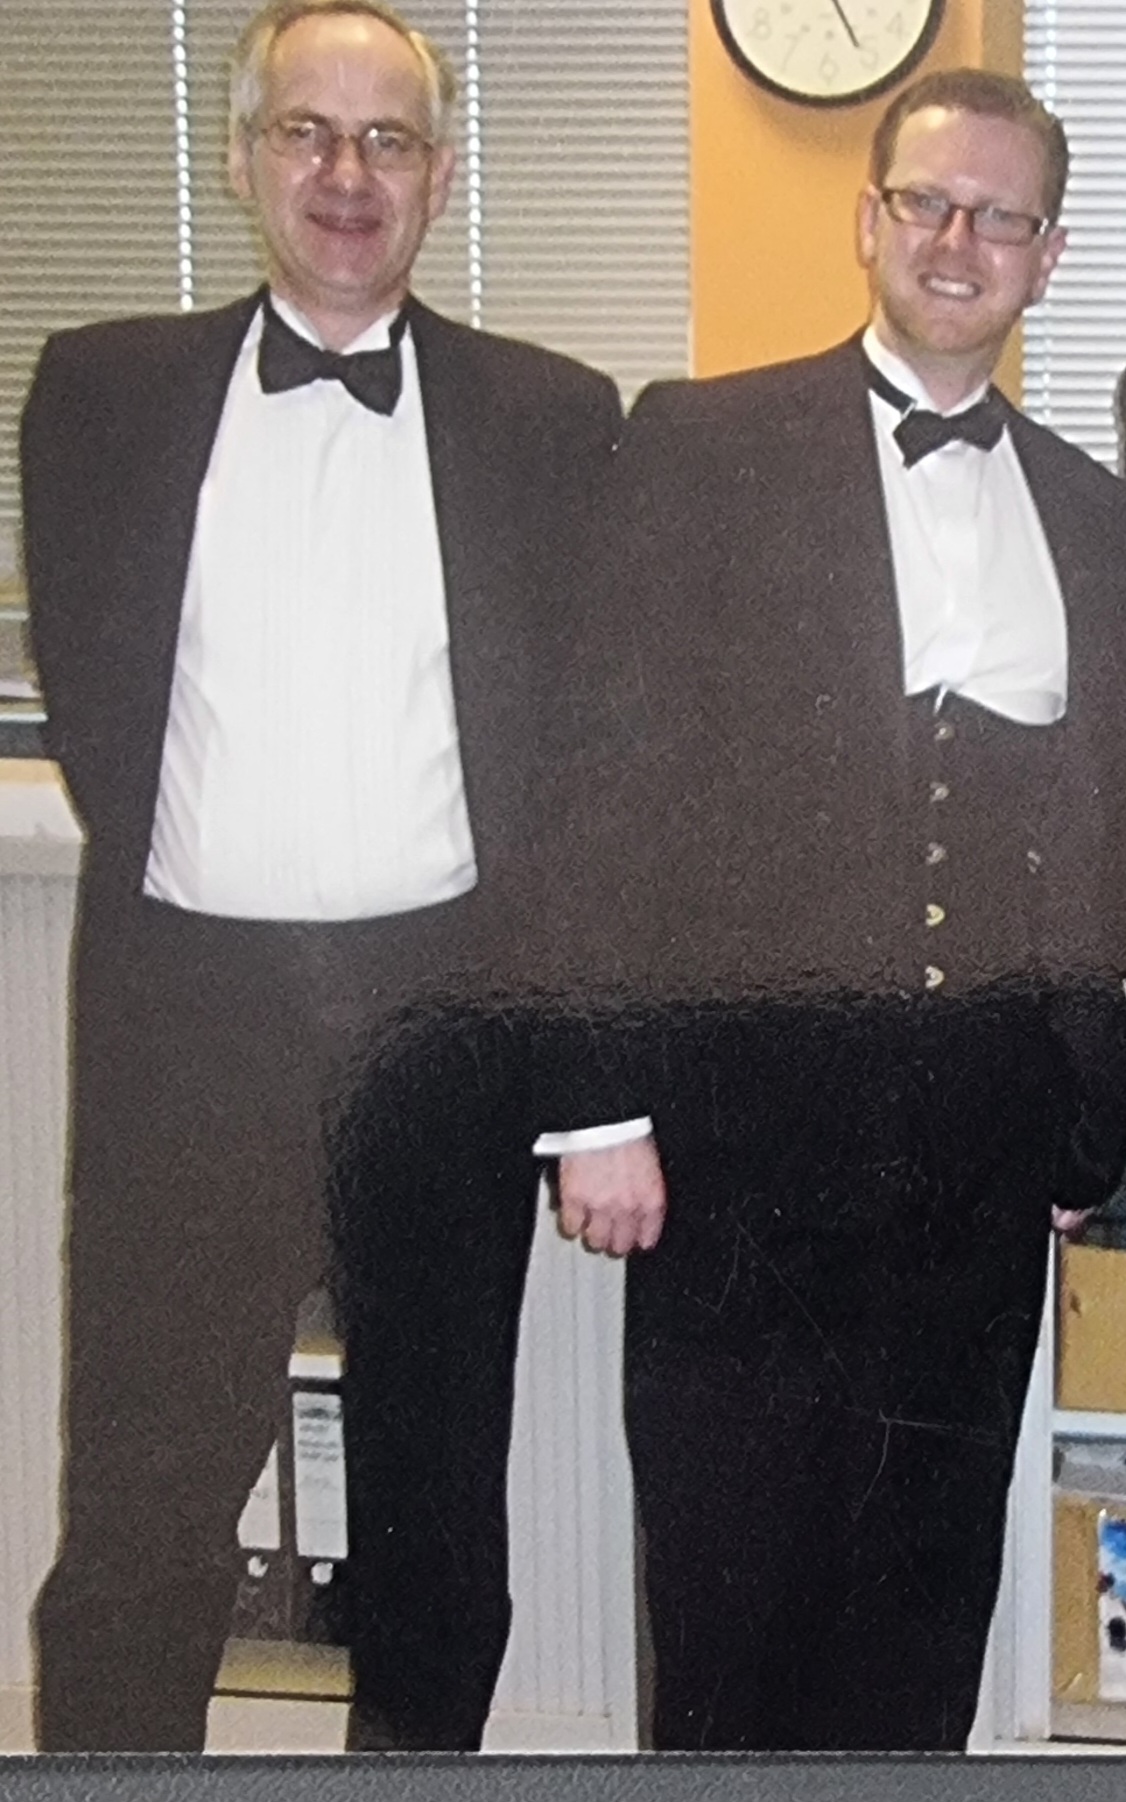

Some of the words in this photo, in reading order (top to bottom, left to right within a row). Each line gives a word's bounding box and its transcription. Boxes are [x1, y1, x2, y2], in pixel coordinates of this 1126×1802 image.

[751, 6, 772, 41] 8
[885, 11, 908, 41] 4
[782, 33, 801, 74] 7
[818, 51, 840, 88] 6
[859, 34, 880, 71] 5
